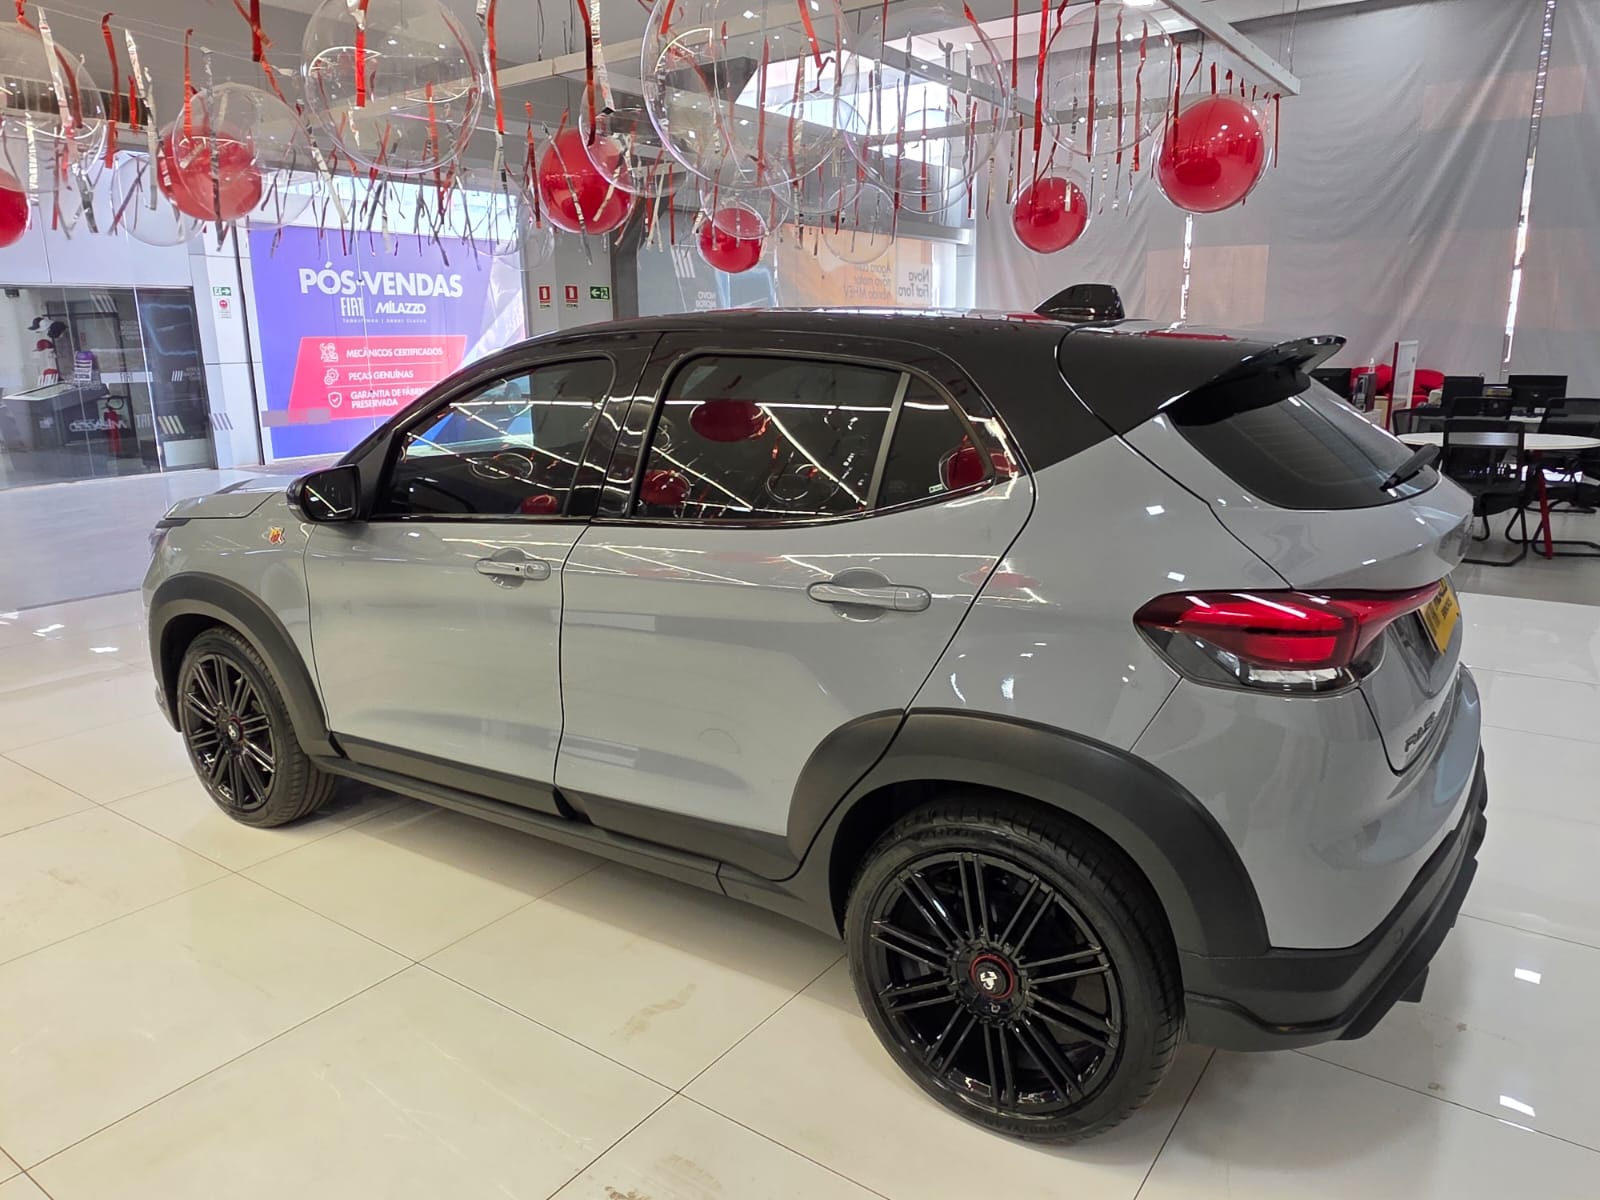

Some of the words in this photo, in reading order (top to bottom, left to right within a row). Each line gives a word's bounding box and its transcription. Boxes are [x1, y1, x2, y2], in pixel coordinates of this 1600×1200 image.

[299, 261, 463, 298] PÓS-VENDAS
[340, 297, 364, 317] FIAT
[346, 346, 393, 359] MECÂNICOS
[393, 346, 443, 357] CERTIFICADOS
[348, 370, 372, 382] PEÇAS
[373, 368, 414, 380] GENUÍNAS
[350, 388, 390, 400] GARANTIA
[391, 388, 402, 397] DE
[351, 398, 399, 409] PRESERVADA
